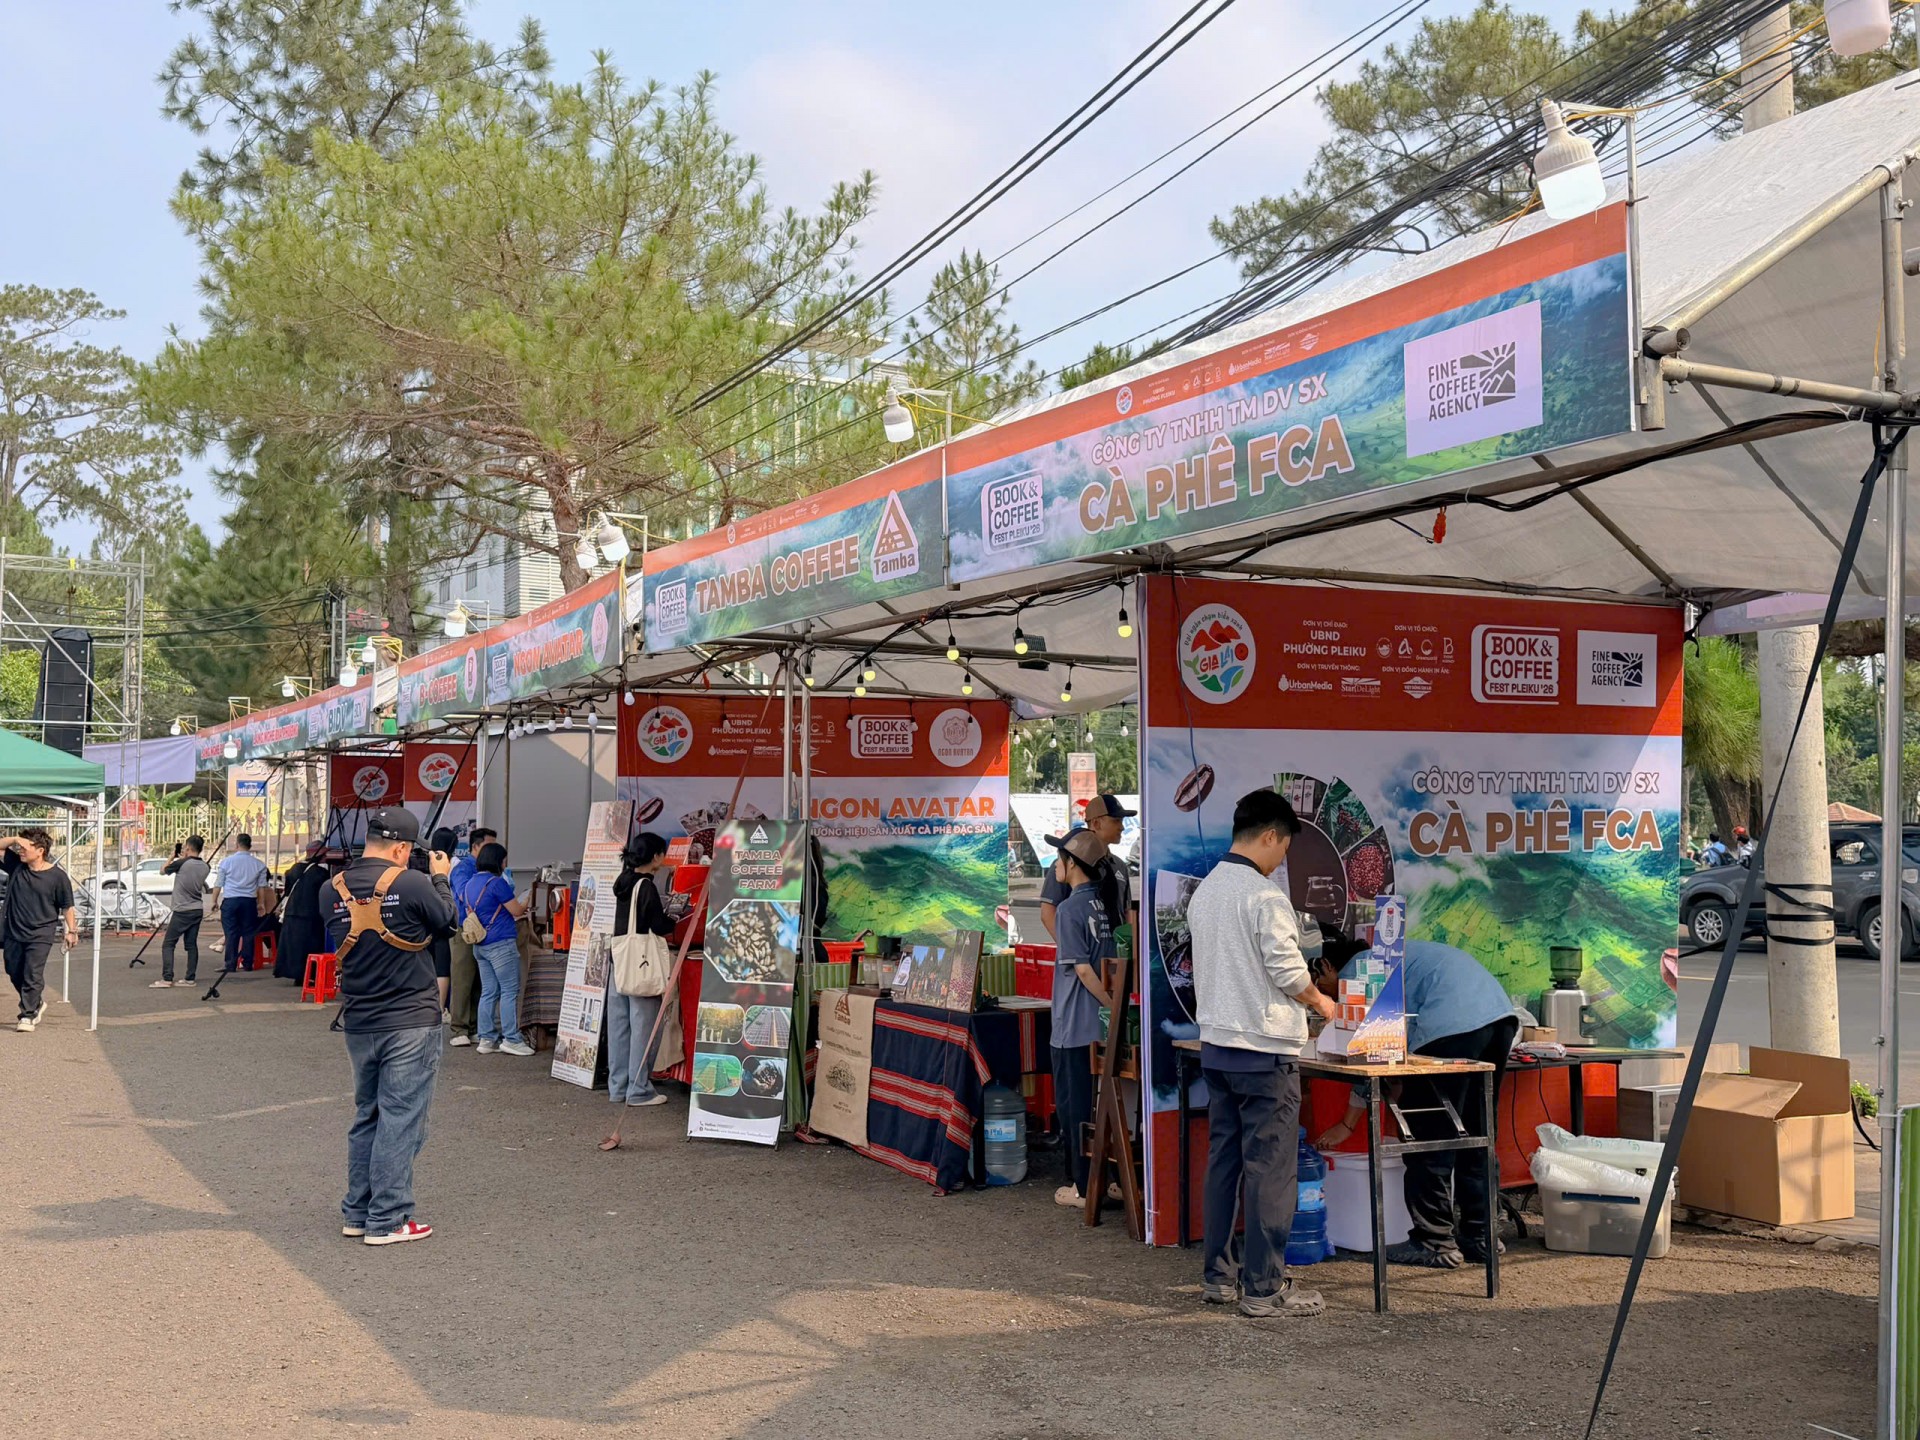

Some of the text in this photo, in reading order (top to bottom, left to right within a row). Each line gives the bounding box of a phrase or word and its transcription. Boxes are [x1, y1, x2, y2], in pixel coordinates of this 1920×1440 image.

[1428, 359, 1458, 383] FINE
[1429, 373, 1477, 401] COFFEE
[1429, 391, 1481, 422] AGENCY
[1092, 372, 1328, 465] CÔNG TY TNHH TM DV SX
[1079, 414, 1355, 535] CÀ PHÊ FCA
[994, 481, 1039, 508] BOOK &
[994, 501, 1040, 530] COFFEE
[994, 532, 1008, 544] FEST
[1009, 525, 1030, 540] PLEIKU
[874, 552, 916, 576] Tamba
[695, 533, 860, 616] TAMBA COFFEE
[661, 587, 679, 604] BOOK
[661, 601, 685, 619] COFFEE
[1310, 630, 1341, 641] UBND
[1283, 641, 1367, 657] PHƯỜNG PLEIKU
[1491, 636, 1554, 657] BOOK &
[1592, 650, 1611, 662] FINE
[1490, 659, 1553, 680] COFFEE
[1592, 662, 1621, 675] COFFEE
[1289, 679, 1333, 691] UrbanMedia
[1489, 682, 1554, 695] FEST PLEIKU '26
[1592, 675, 1624, 687] AGENCY
[328, 702, 349, 735] BIDV
[864, 720, 909, 732] BOOK &
[745, 727, 772, 735] PLEIKU
[864, 733, 909, 745] COFFEE
[1412, 766, 1659, 794] CÔNG TY TNHH TM DV SX
[886, 796, 995, 818] AVATAR
[844, 825, 867, 839] HIỆU
[891, 823, 917, 836] XUẤT
[917, 823, 931, 836] CÀ
[932, 823, 952, 835] PHÊ
[953, 823, 974, 837] ĐẶC
[1408, 797, 1664, 857] CÀ PHÊ FCA
[735, 849, 782, 861] TAMBA
[731, 864, 783, 875] COFFEE
[739, 879, 777, 890] FARM
